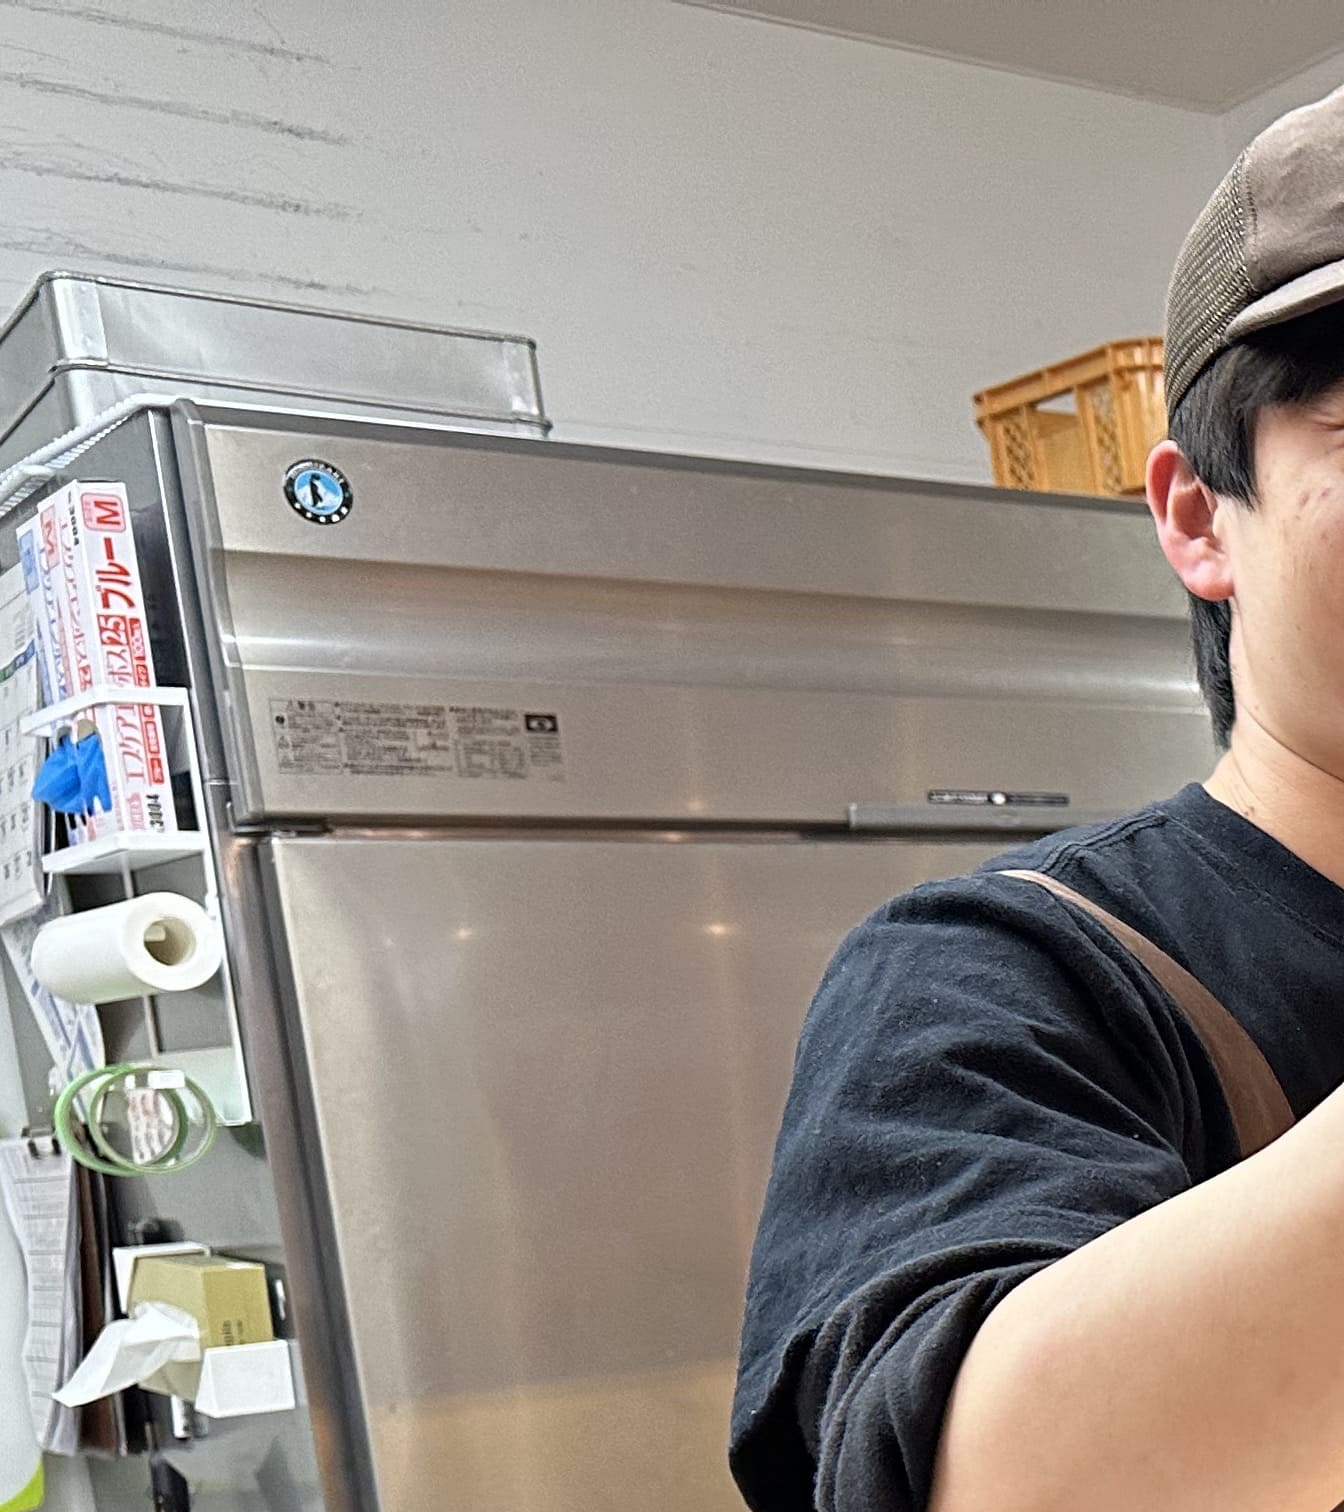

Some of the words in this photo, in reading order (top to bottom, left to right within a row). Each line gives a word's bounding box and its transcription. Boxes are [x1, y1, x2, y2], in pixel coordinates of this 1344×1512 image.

[94, 500, 121, 526] M
[96, 537, 135, 609] ブルー
